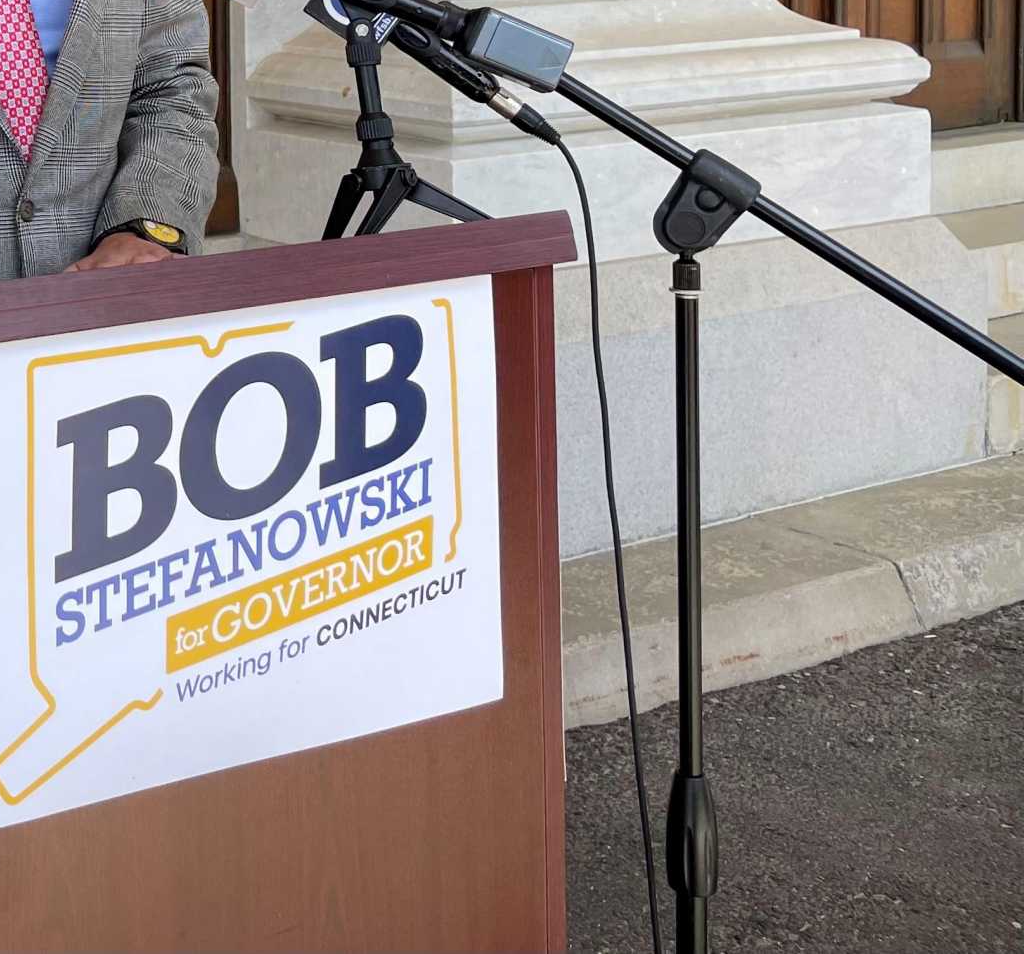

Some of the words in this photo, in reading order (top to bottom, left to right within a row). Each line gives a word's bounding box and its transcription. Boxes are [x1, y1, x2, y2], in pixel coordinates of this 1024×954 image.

[54, 314, 428, 584] BOB
[55, 458, 433, 647] STEFANOWSKI
[174, 627, 208, 654] for
[211, 529, 426, 644] GOVERNOR
[176, 648, 272, 702] Working
[278, 634, 310, 663] for
[316, 568, 467, 647] CONNECTICUT
